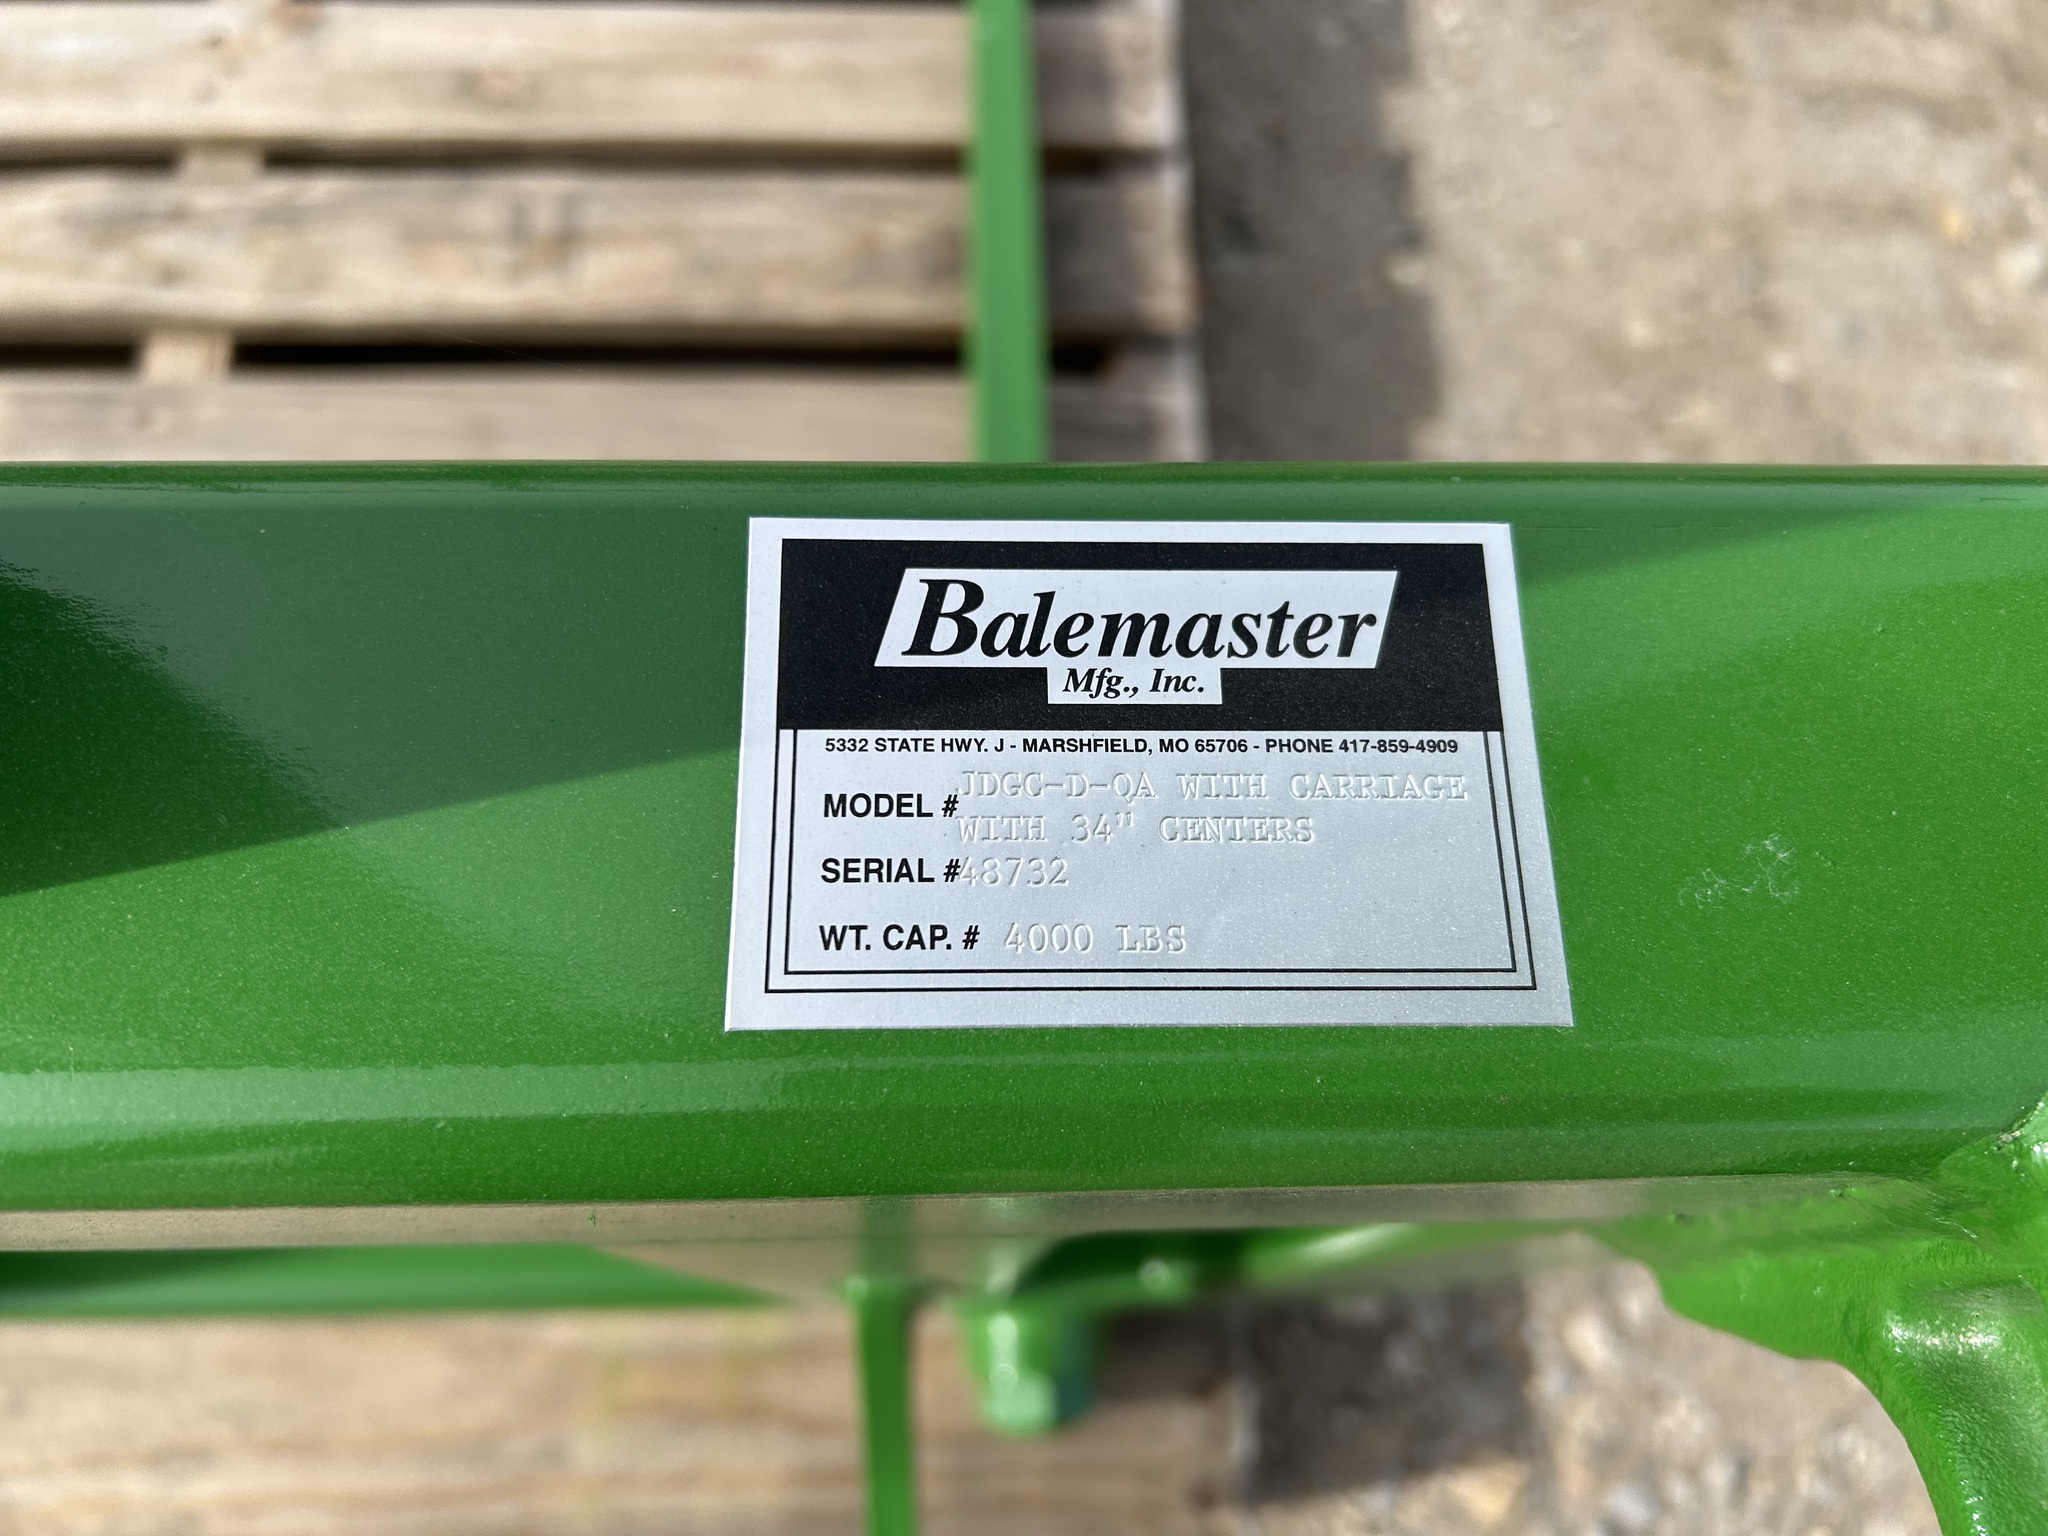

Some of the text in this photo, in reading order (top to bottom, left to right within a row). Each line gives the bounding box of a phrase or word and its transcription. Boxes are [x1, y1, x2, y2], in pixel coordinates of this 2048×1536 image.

[901, 578, 1377, 660] Balemaster
[1062, 668, 1205, 699] Mfg., Inc.
[825, 738, 869, 753] 5332
[874, 738, 935, 753] STATE
[941, 738, 988, 753] HWY.
[994, 738, 1004, 753] J
[1022, 738, 1153, 756] MARSHFIELD,
[1159, 738, 1189, 753] MO
[1194, 738, 1248, 753] 65706
[1265, 738, 1333, 753] PHONE
[1338, 739, 1458, 754] 417-859-4909
[956, 770, 1468, 805] JDGC-D-QA WITH CARRIAGE
[823, 793, 934, 818] MODEL
[956, 812, 1315, 844] WITH 34" CENTERS
[821, 857, 935, 883] SERIAL
[819, 922, 1188, 954] WT. CAP. # 4000 LBS
